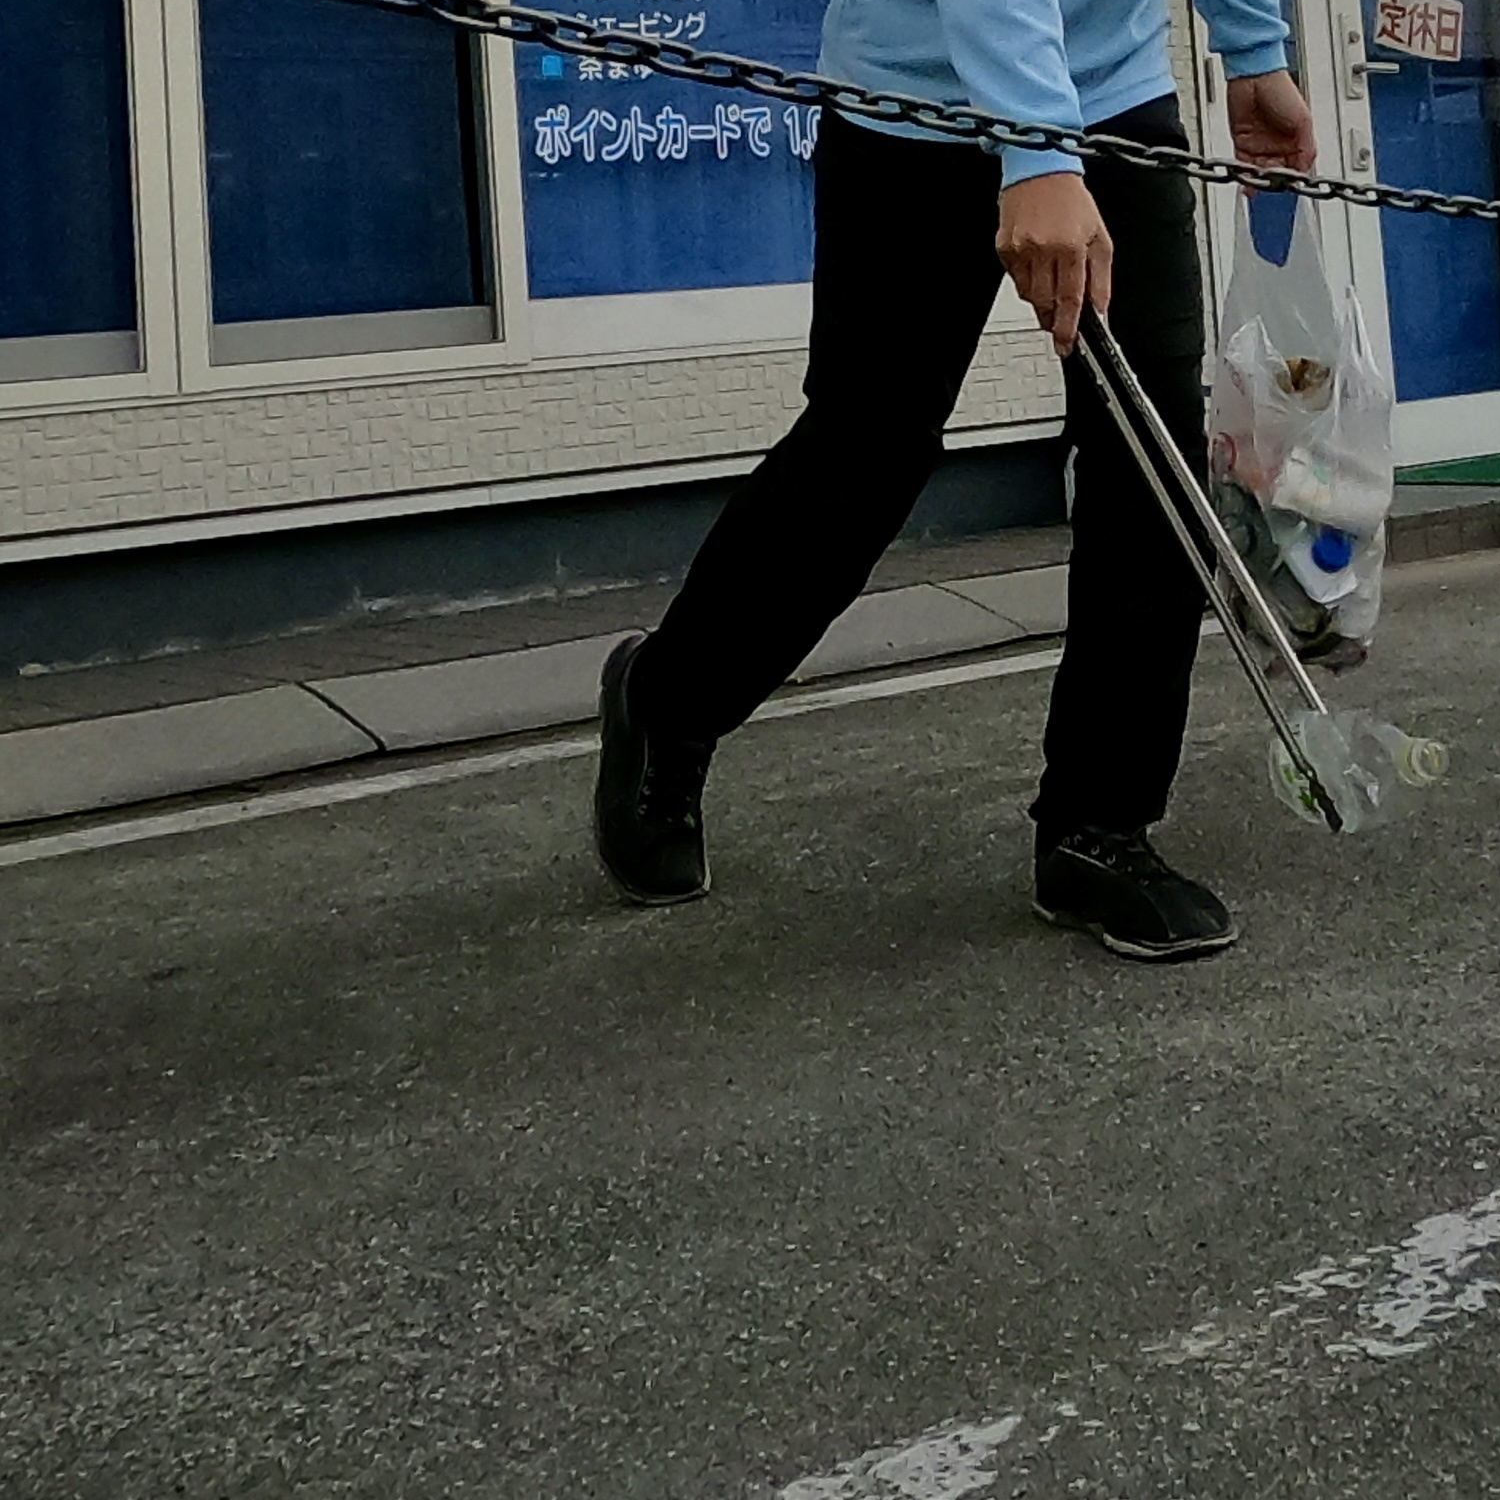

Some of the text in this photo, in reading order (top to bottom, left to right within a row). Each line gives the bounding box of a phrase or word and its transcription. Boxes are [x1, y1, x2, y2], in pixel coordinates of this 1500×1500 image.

[535, 104, 772, 165] ポイントカードで
